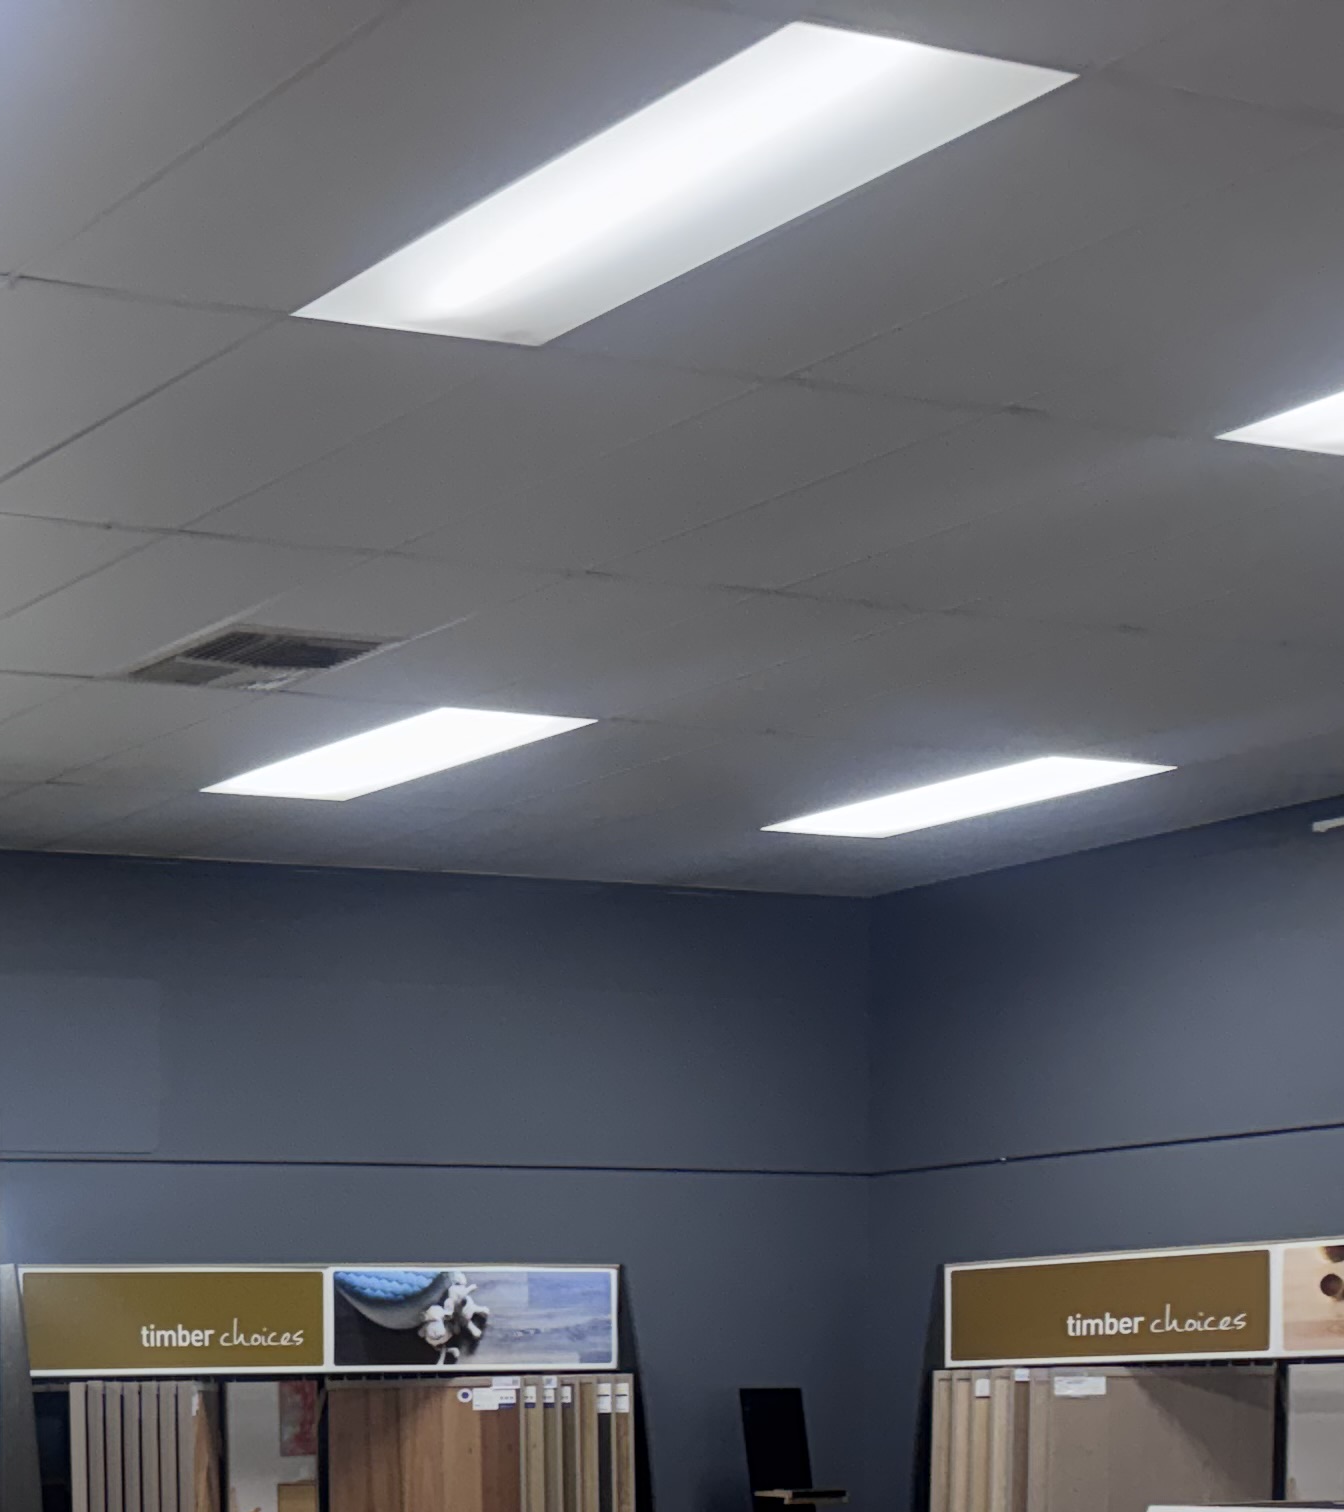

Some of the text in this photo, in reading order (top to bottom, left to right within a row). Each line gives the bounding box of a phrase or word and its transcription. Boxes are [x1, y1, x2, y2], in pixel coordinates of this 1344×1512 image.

[140, 1317, 305, 1348] timber choices
[1066, 1303, 1248, 1337] timber choices
